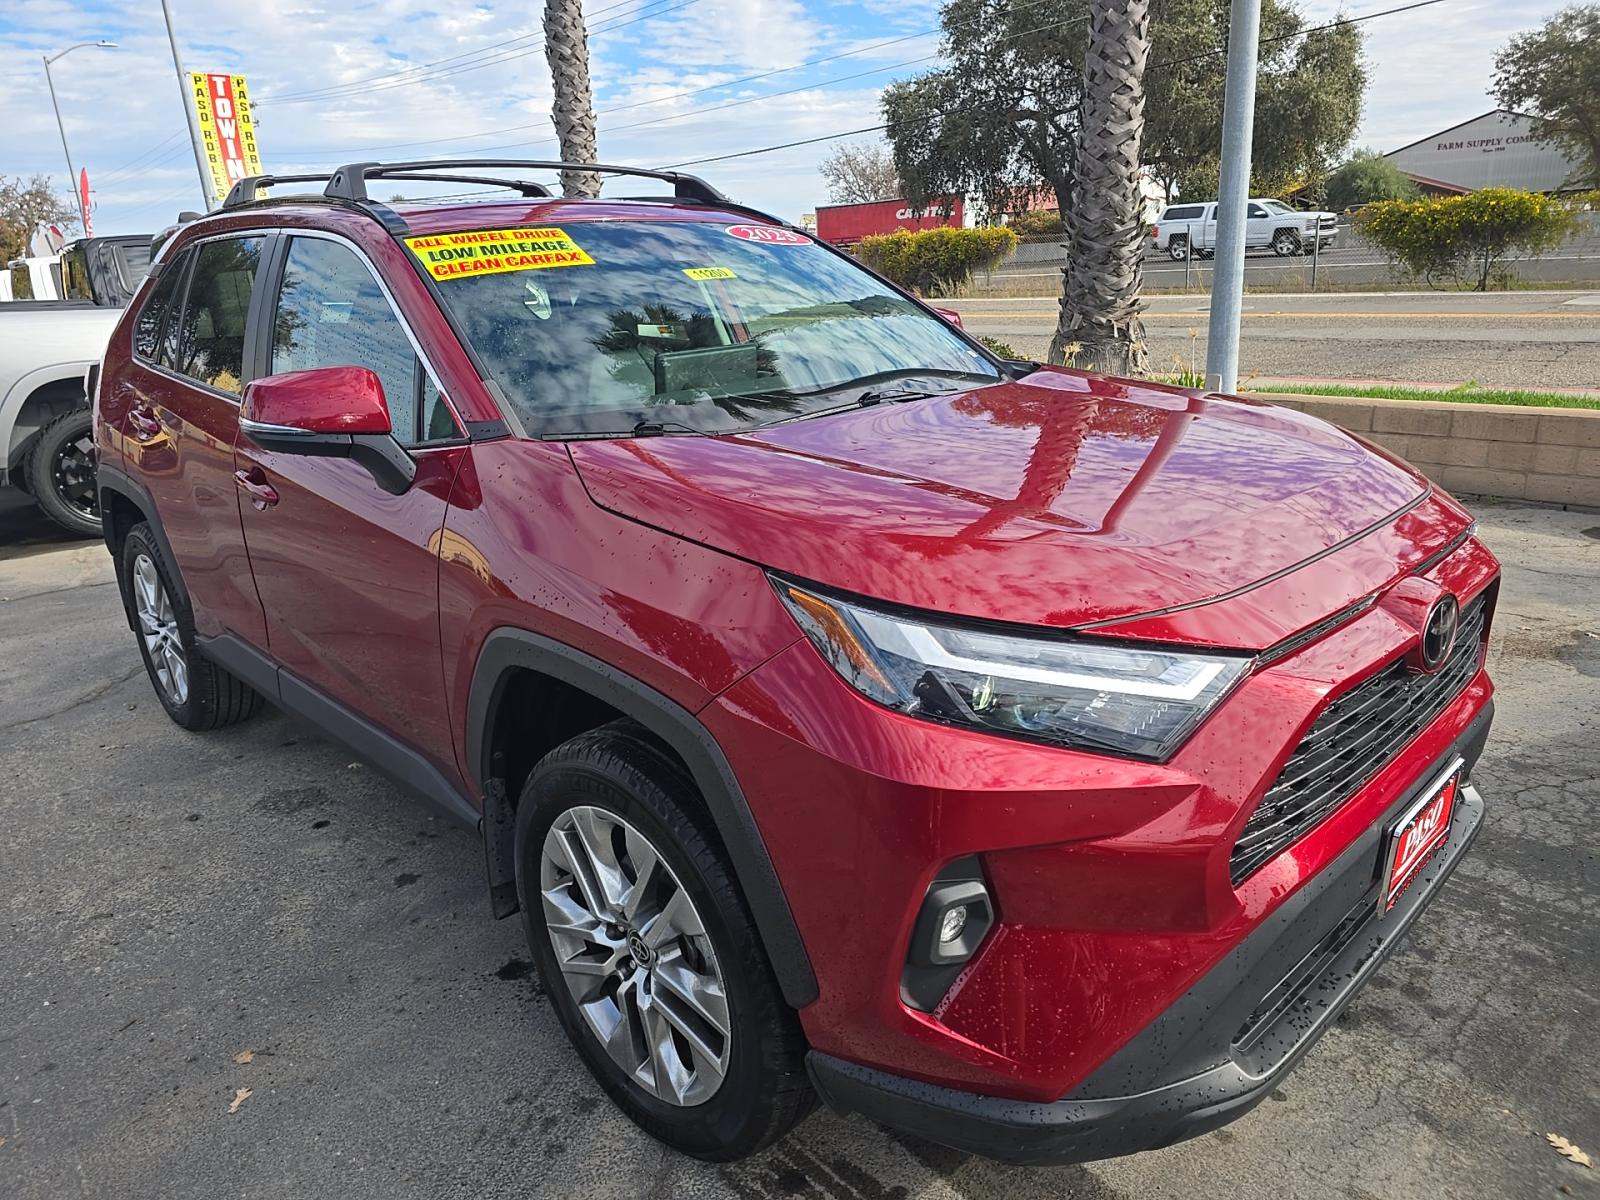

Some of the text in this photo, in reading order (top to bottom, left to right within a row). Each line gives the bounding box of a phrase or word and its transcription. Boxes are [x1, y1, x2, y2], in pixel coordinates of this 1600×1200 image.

[194, 76, 226, 197] PASO ROBLES
[209, 76, 246, 186] TOWIN
[237, 79, 267, 197] PASO ROBLS
[1437, 132, 1556, 151] FARM SUPPLY COMP
[413, 229, 561, 249] ALL WHEEL DRIVE
[428, 240, 568, 262] LOW MILEAGE
[433, 252, 581, 276] CLEAN CARFAX
[1402, 796, 1444, 863] PASO
